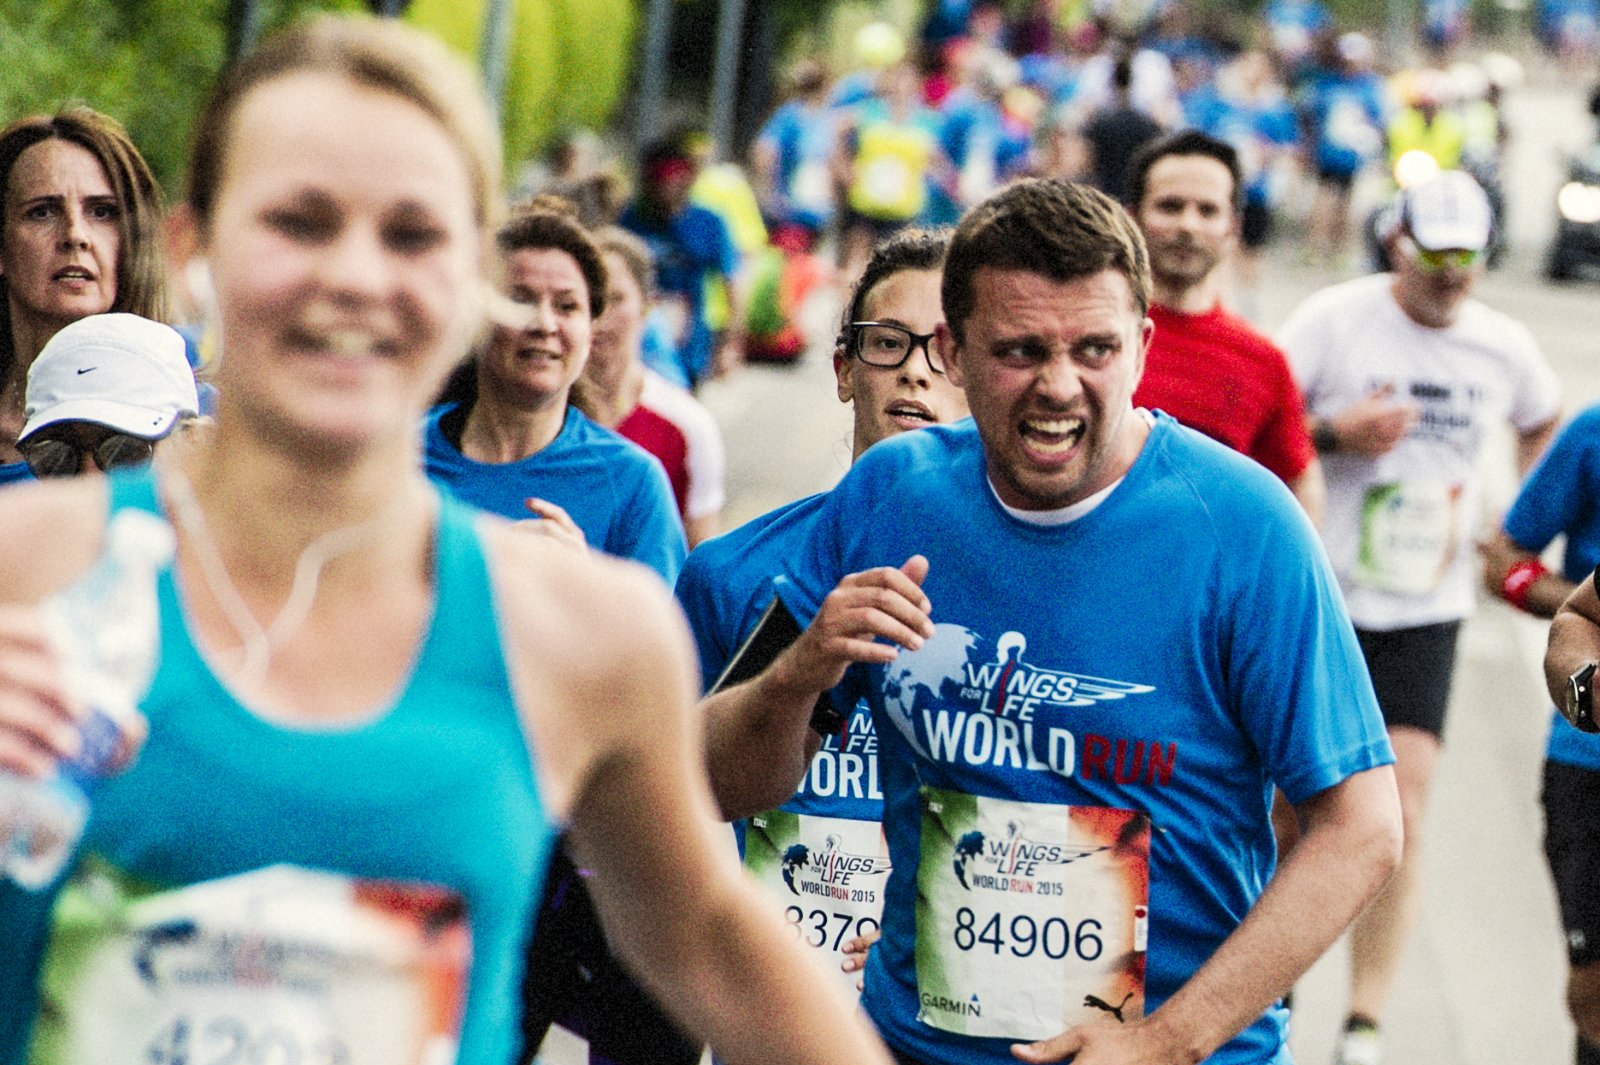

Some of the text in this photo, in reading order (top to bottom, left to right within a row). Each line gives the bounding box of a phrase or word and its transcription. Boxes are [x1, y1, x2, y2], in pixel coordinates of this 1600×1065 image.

[967, 660, 1078, 701] WINGS
[960, 687, 1041, 722] FOR LIFE
[923, 709, 1178, 786] WORLD RUN
[797, 750, 884, 800] ORL
[813, 851, 874, 873] WINGS
[990, 838, 1061, 862] WINGS
[821, 869, 854, 886] LIFE
[997, 859, 1039, 877] LIFE
[801, 880, 875, 903] WORLD RUN 2015
[972, 873, 1064, 896] WORLD RUN 2015
[953, 907, 1104, 961] 84906
[921, 992, 982, 1017] GARMIN
